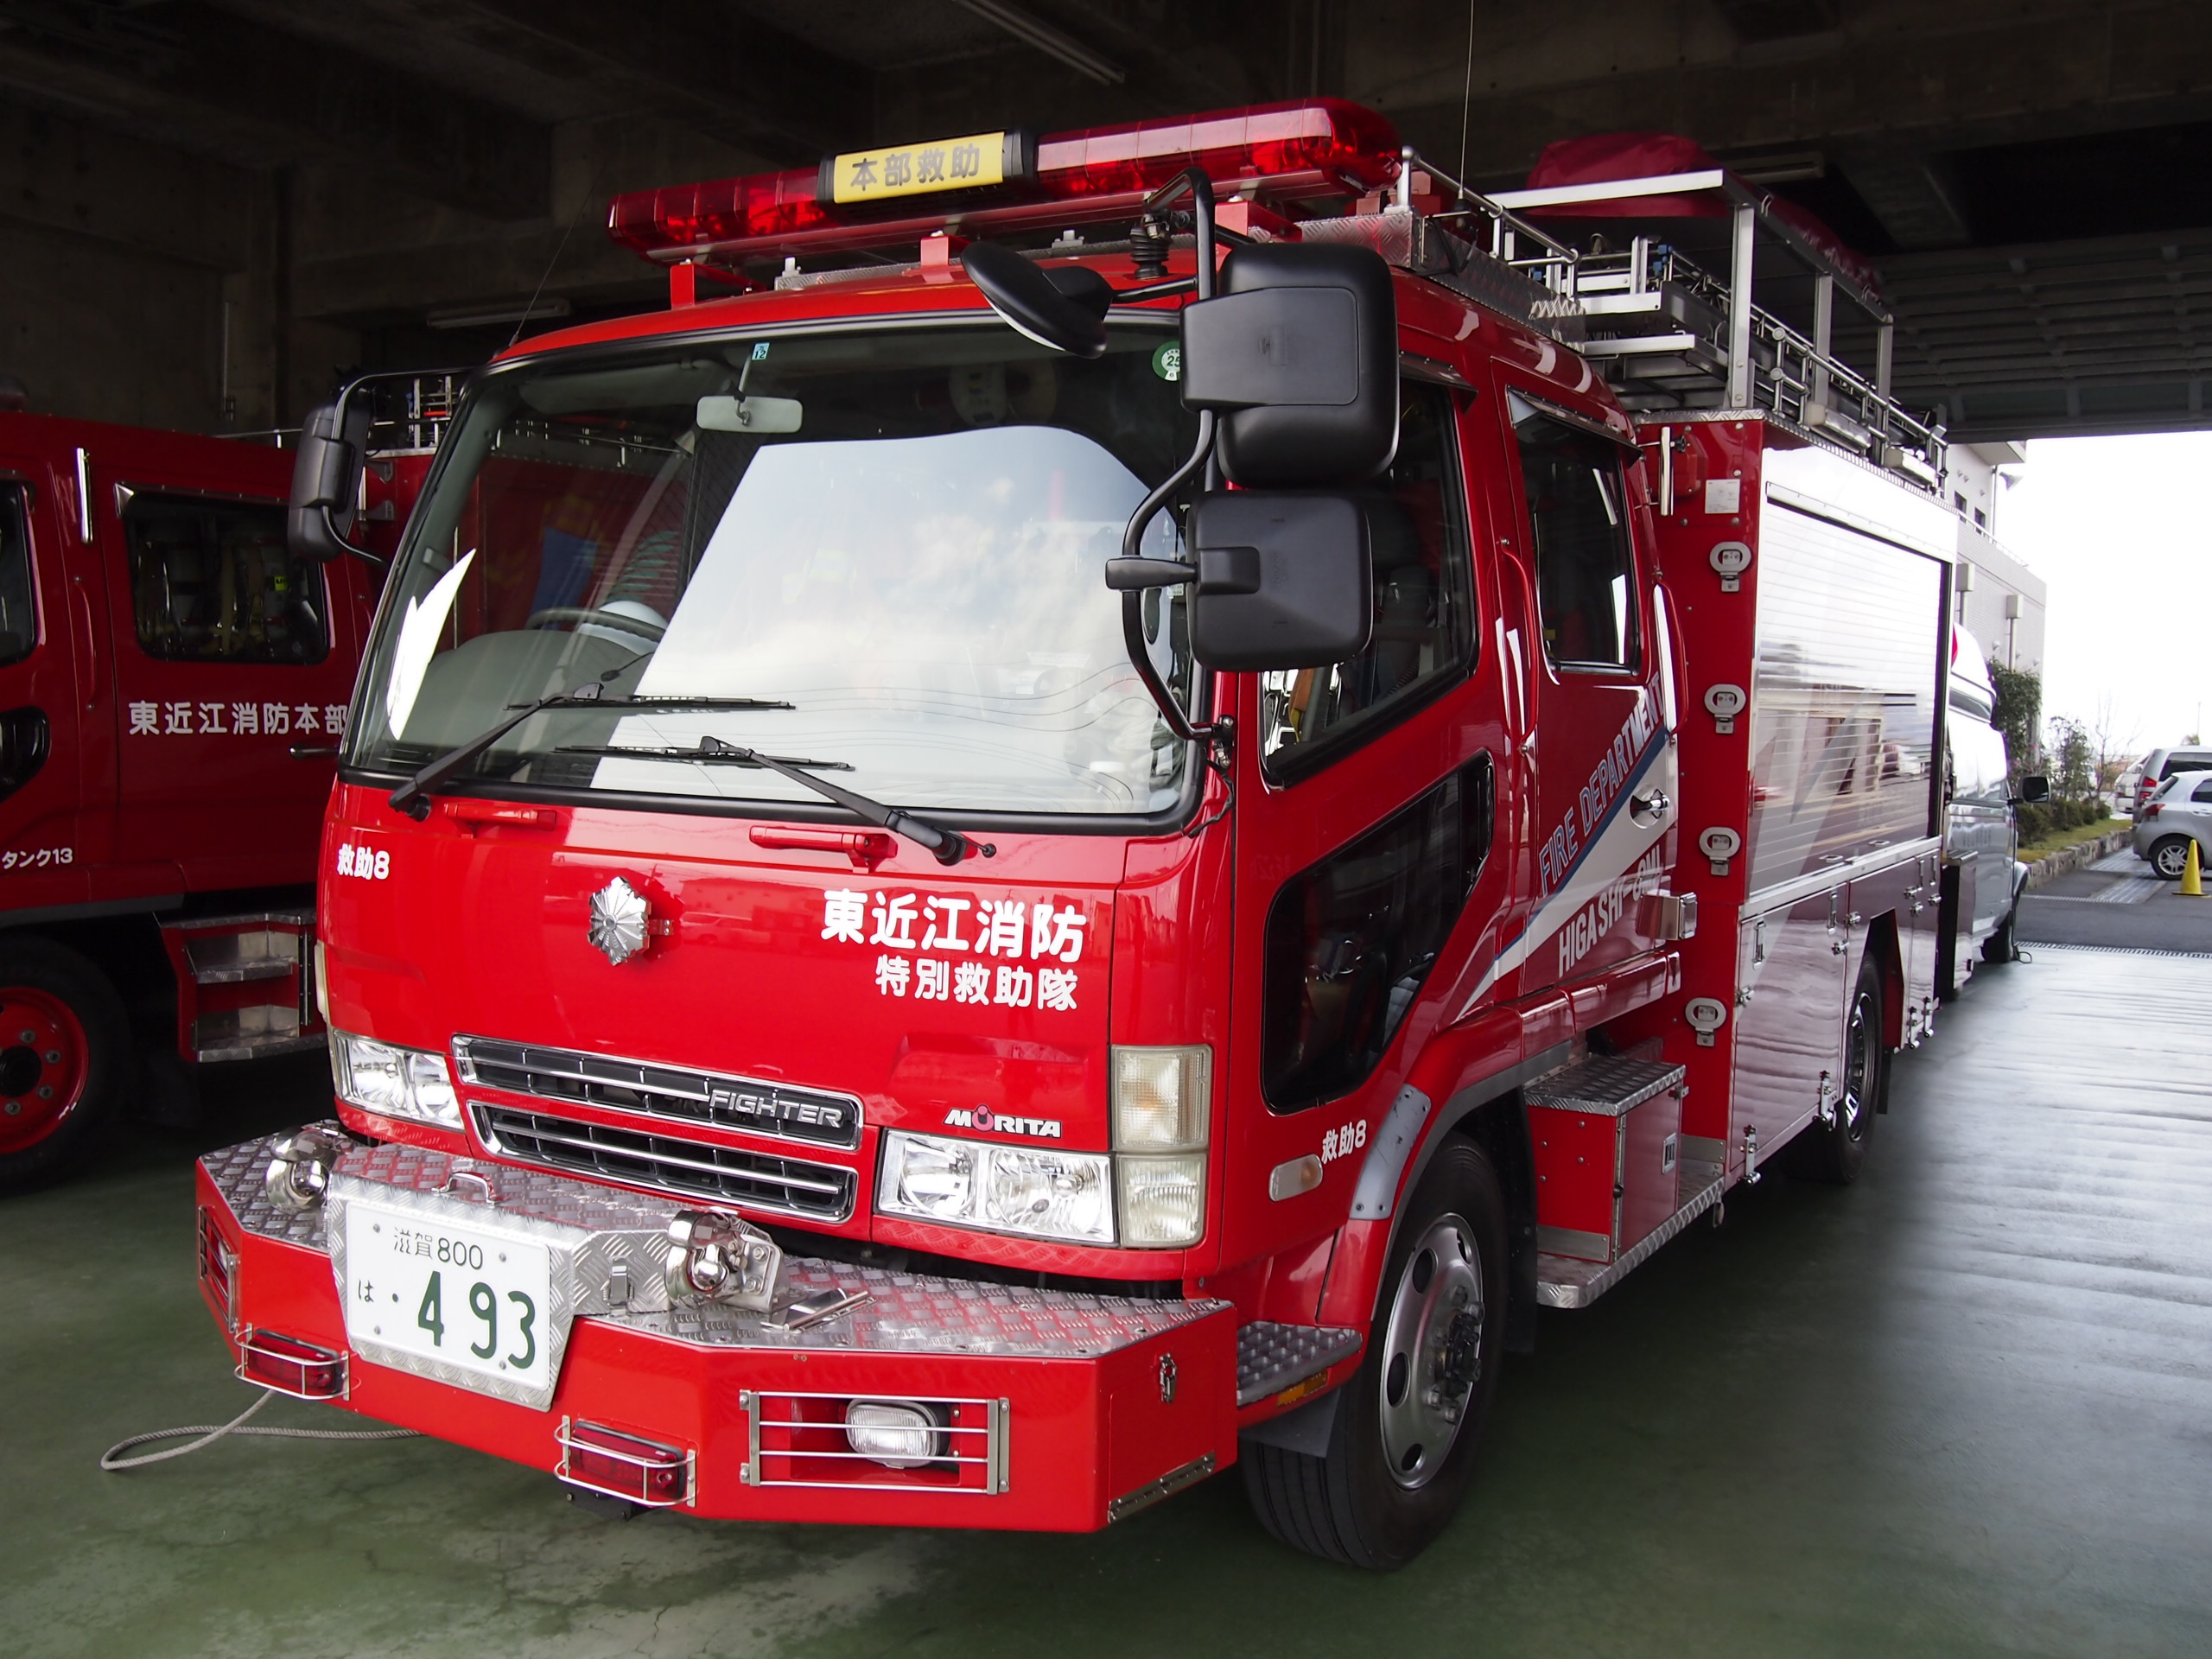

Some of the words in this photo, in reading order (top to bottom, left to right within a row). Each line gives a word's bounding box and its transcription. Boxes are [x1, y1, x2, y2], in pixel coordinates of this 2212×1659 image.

[849, 143, 980, 192] 本部救助
[754, 350, 766, 359] 12
[1166, 354, 1180, 367] 25
[128, 700, 347, 735] 東近江消防本部
[1539, 806, 1579, 899] FIRE
[1580, 671, 1664, 836] DEPARTMENT
[2, 848, 73, 869] タンク13
[337, 842, 390, 880] 救助8
[821, 888, 1086, 963] 東近江消防
[875, 954, 1077, 1011] 特別救助隊
[709, 1089, 843, 1128] FIGHTER
[944, 1104, 1062, 1138] MORITA
[1321, 1119, 1367, 1165] 救助8
